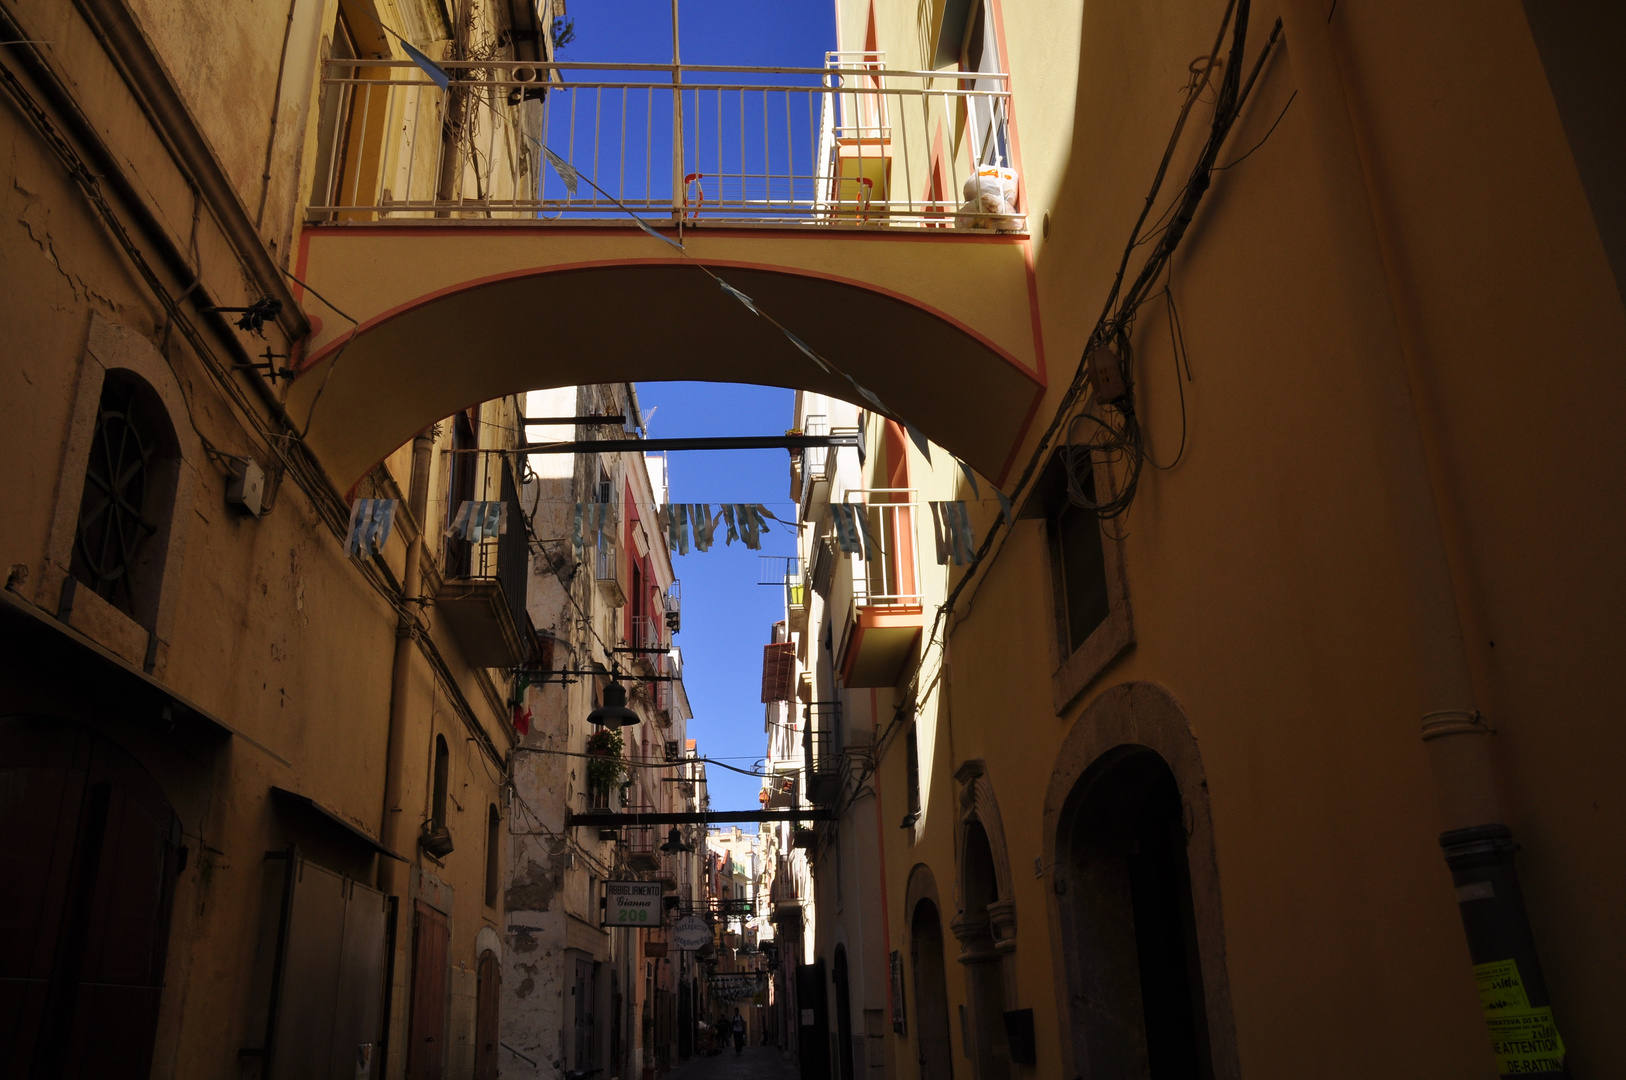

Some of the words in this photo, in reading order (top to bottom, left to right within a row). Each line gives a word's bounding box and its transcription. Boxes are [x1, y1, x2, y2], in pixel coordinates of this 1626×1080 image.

[608, 885, 660, 896] ABBIGLIAMENTO
[617, 896, 651, 907] Gianna
[1503, 1038, 1558, 1054] ATTENTION
